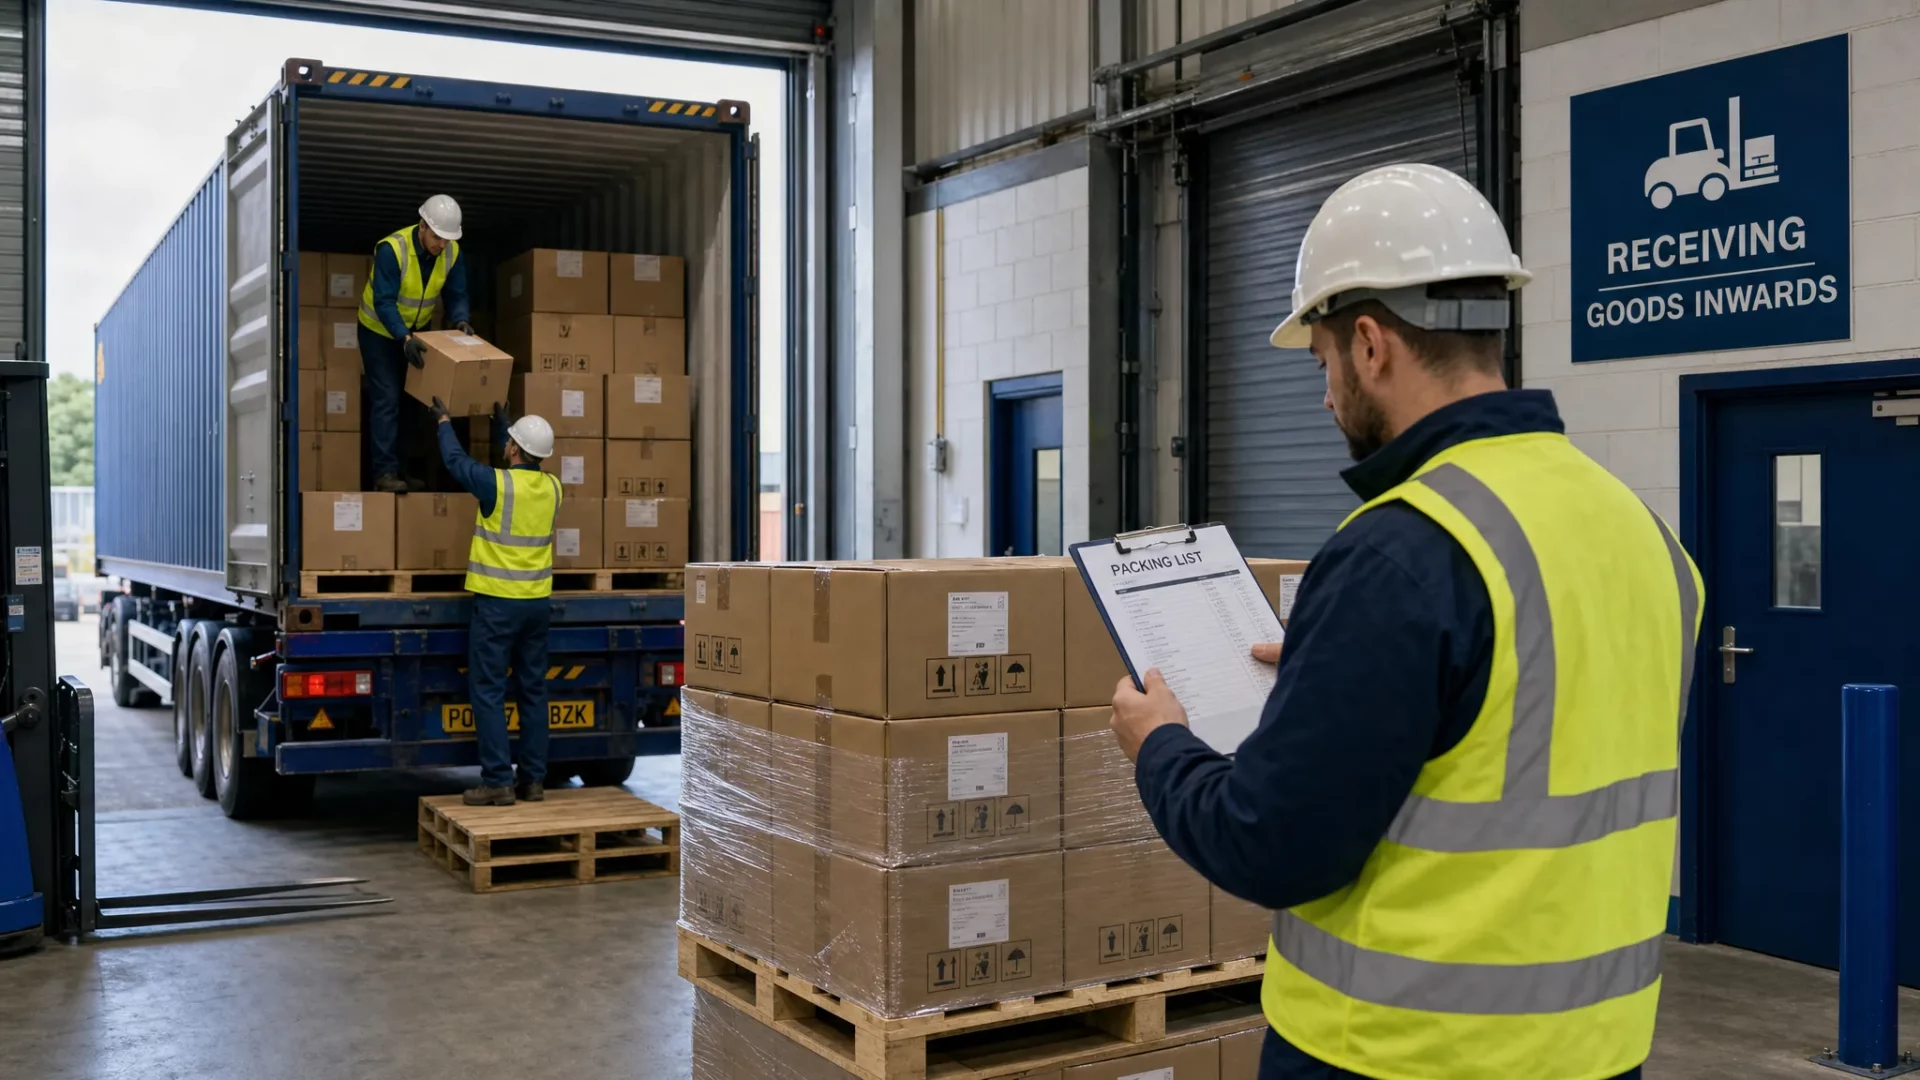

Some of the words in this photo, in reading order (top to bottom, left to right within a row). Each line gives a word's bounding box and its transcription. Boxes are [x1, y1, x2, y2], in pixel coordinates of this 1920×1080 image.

[1607, 216, 1806, 275] RECEIVING
[1587, 292, 1684, 328] GOODS
[1695, 274, 1838, 317] INWARDS
[1110, 556, 1173, 577] PACKING
[1174, 551, 1203, 566] LIST
[550, 704, 587, 725] BZK
